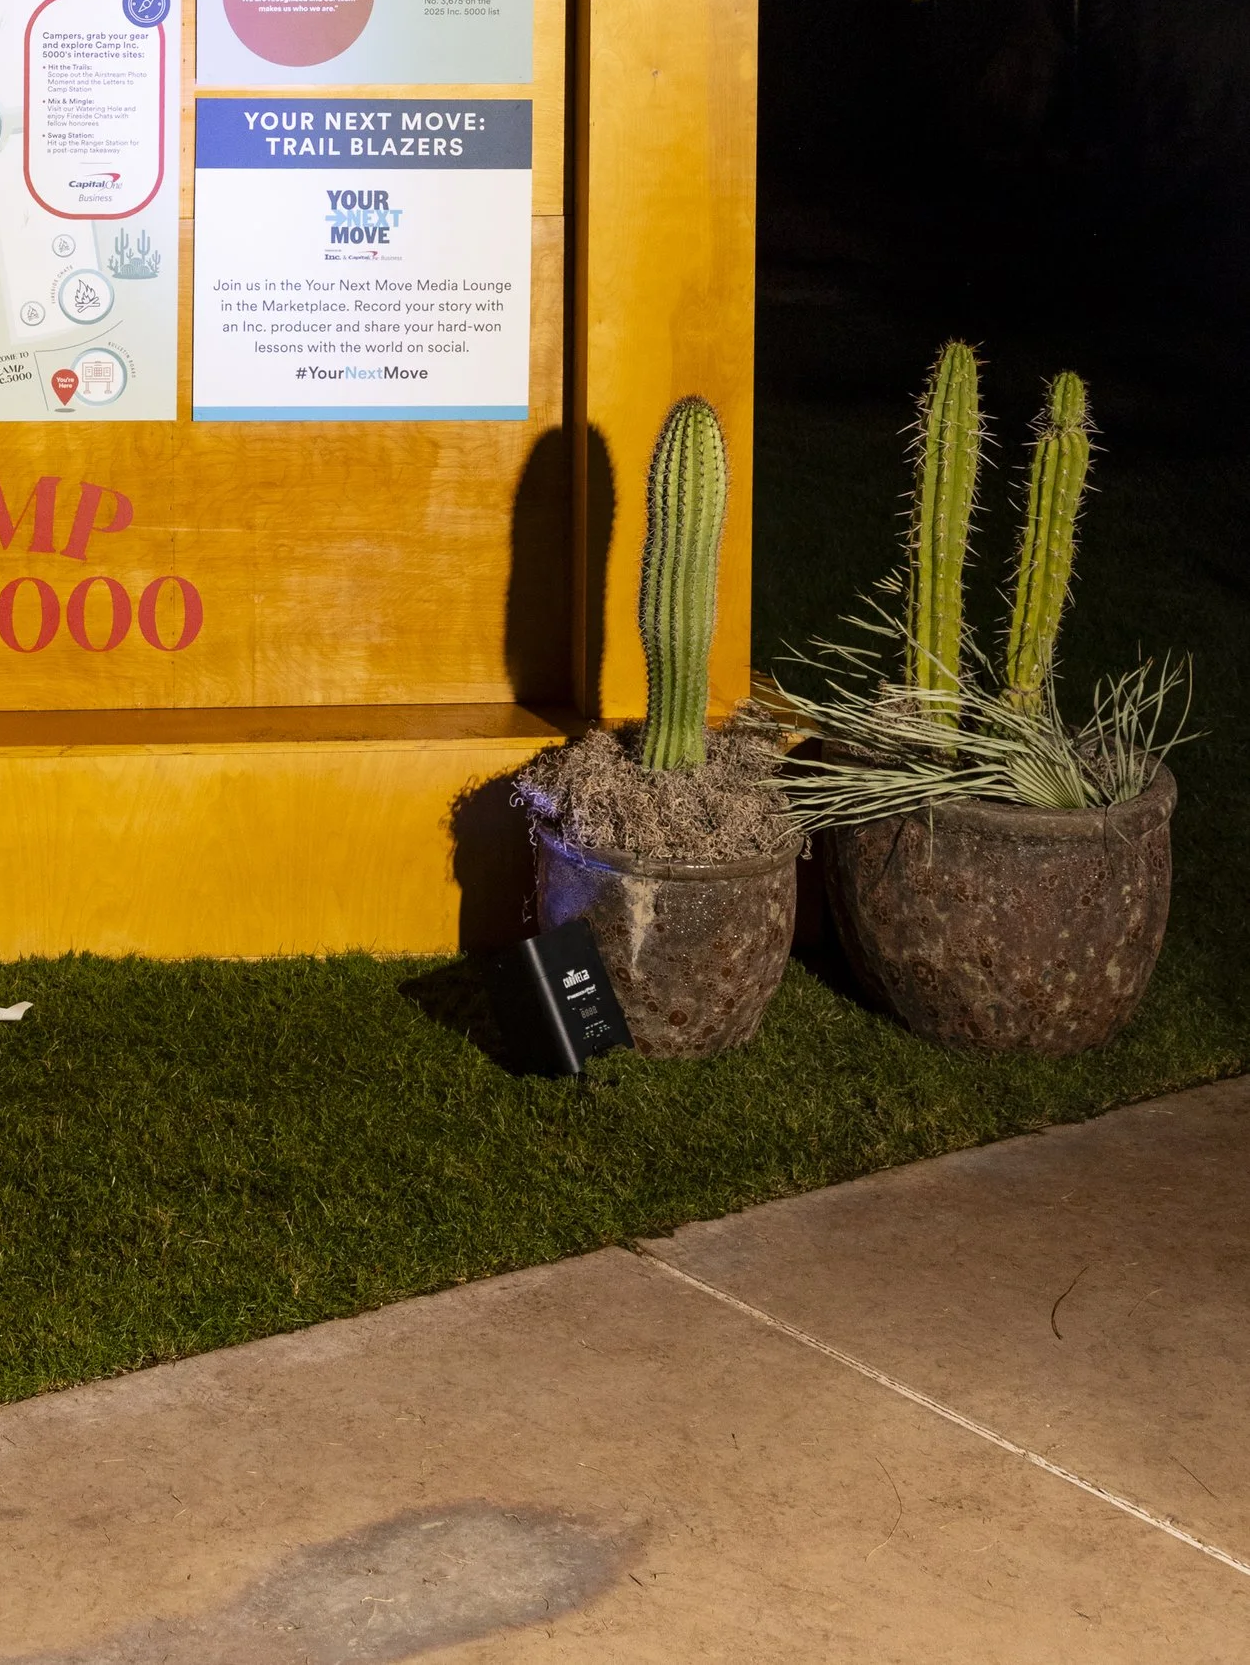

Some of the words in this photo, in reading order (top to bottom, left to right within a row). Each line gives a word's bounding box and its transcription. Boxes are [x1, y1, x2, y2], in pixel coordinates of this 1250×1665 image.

[424, 8, 445, 16] 2025
[464, 8, 486, 16] 5000
[488, 7, 500, 15] list
[42, 31, 84, 42] Campers,
[86, 32, 106, 42] grab
[42, 41, 58, 49] and
[60, 41, 93, 50] explore
[95, 41, 121, 50] Camp
[123, 41, 139, 49] Inc.
[74, 50, 120, 58] interactive
[244, 112, 314, 130] YOUR
[325, 112, 392, 130] NEXT
[402, 112, 485, 131] MOVE:
[266, 138, 340, 155] TRAIL
[351, 138, 463, 156] BLAZERS
[326, 190, 389, 210] YOUR
[348, 209, 403, 227] NEXT
[331, 227, 390, 244] MOVE
[213, 279, 241, 291] Join
[246, 282, 260, 291] us
[265, 279, 276, 290] in
[280, 279, 301, 291] the
[305, 279, 335, 291] Your
[339, 279, 370, 291] Next
[375, 279, 412, 291] Move
[417, 279, 458, 291] Media
[463, 279, 512, 294] Lounge
[221, 300, 232, 311] in
[236, 300, 257, 312] the
[262, 300, 349, 314] Marketplace.
[354, 300, 401, 312] Record
[405, 303, 435, 314] your
[438, 301, 472, 314] story
[475, 299, 504, 311] with
[222, 324, 238, 332] an
[243, 321, 266, 332] Inc.
[271, 320, 332, 334] producer
[336, 320, 360, 332] and
[364, 321, 400, 332] share
[404, 324, 434, 335] your
[438, 320, 501, 332] hard-won
[255, 341, 303, 353] lessons
[307, 341, 336, 353] with
[340, 341, 361, 353] the
[365, 341, 403, 353] world
[407, 344, 423, 353] on
[428, 341, 469, 353] social.
[295, 366, 428, 379] #YourNextMove
